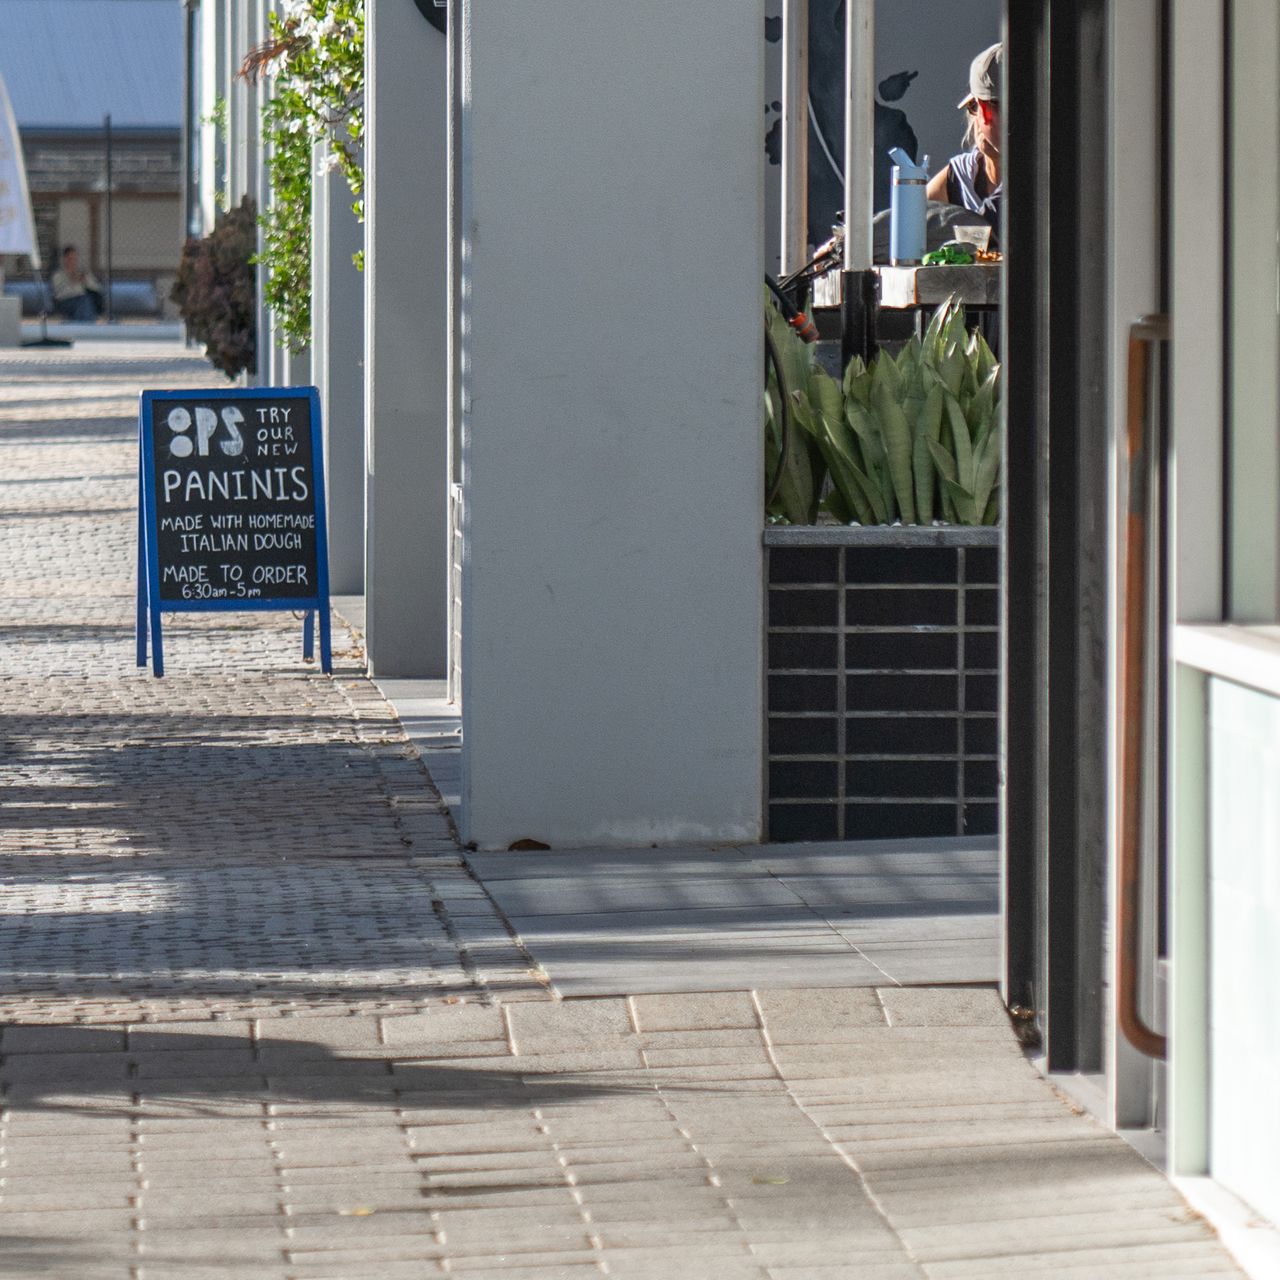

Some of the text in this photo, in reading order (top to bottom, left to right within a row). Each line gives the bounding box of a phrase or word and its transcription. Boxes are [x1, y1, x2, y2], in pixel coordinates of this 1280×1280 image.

[256, 407, 292, 424] TRY
[257, 426, 295, 442] OUR
[257, 443, 299, 457] NEW
[163, 466, 309, 503] PANINIS
[161, 514, 316, 532] MADE WITH HOMEMADE
[180, 532, 303, 553] ITALIAN DOUGH
[163, 564, 309, 585] MADE TO ORDER
